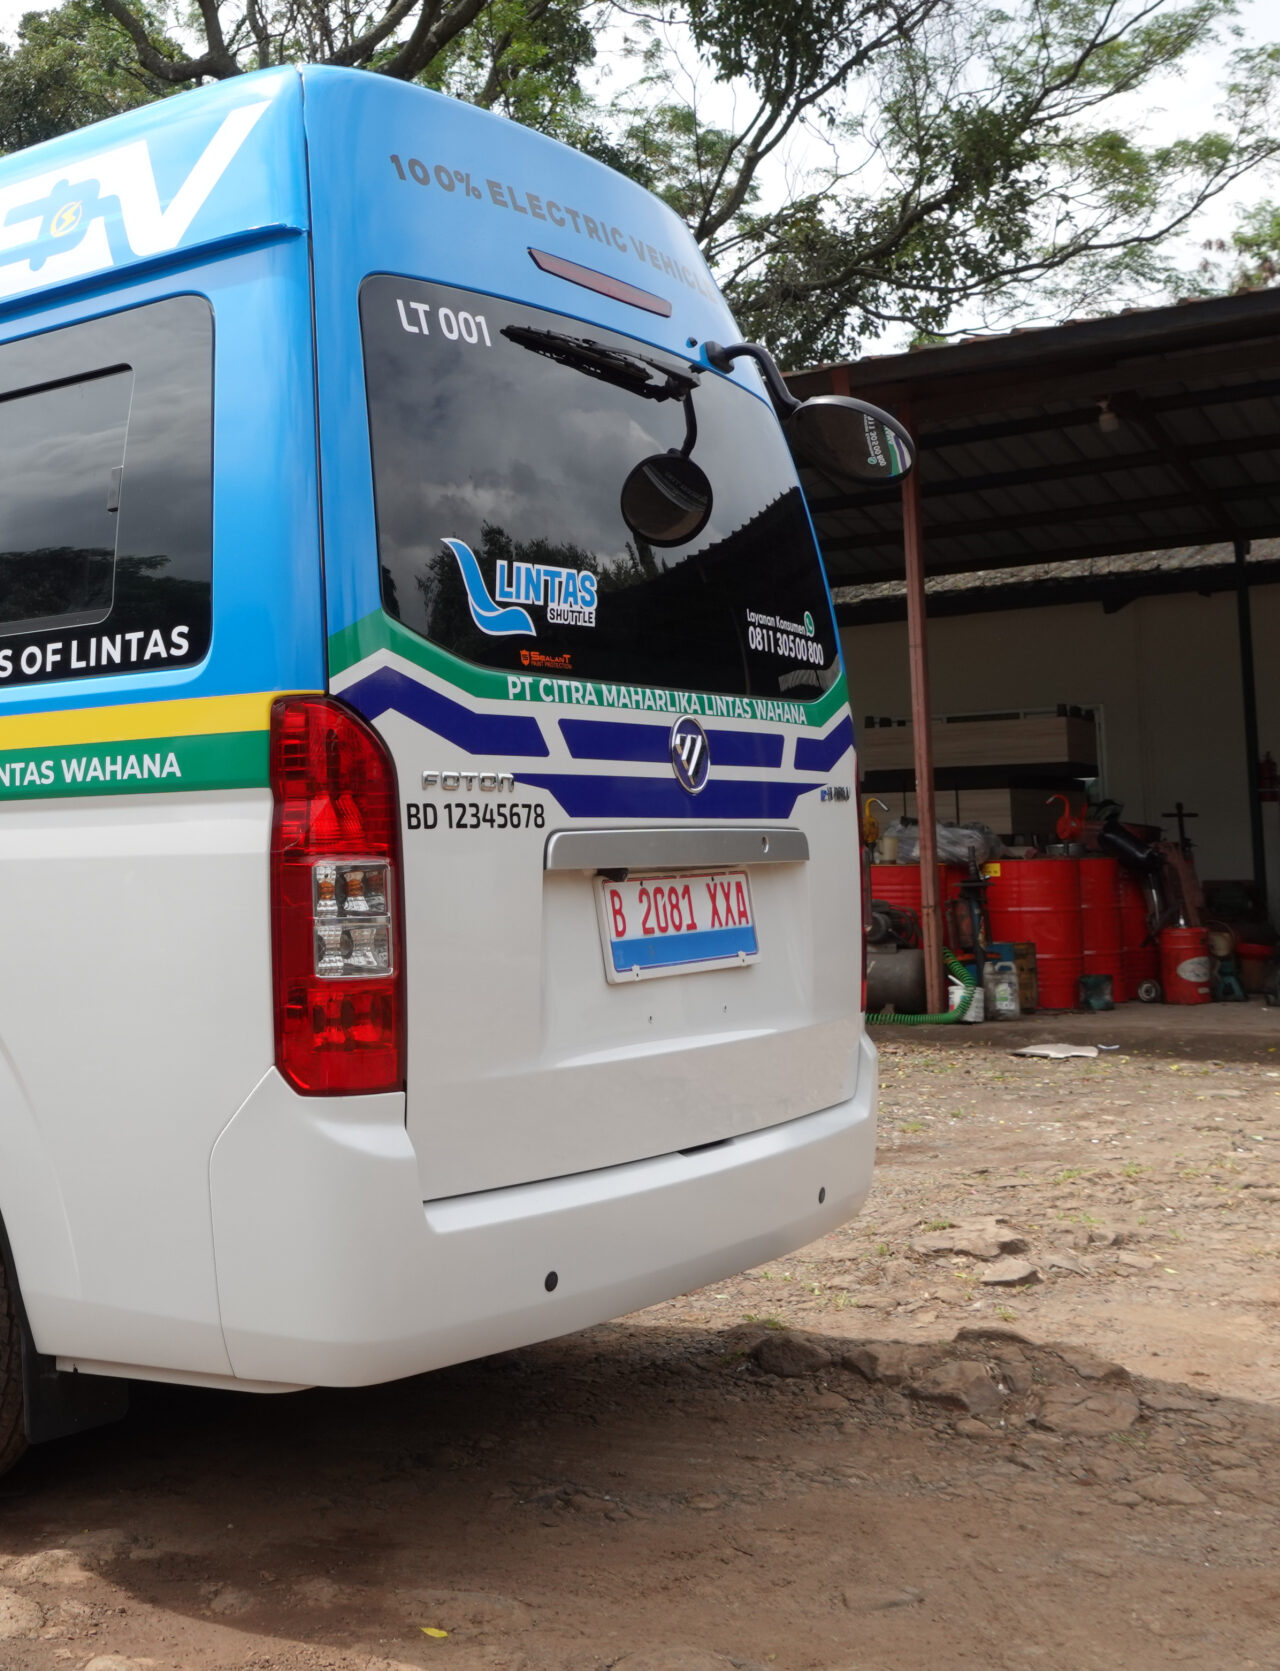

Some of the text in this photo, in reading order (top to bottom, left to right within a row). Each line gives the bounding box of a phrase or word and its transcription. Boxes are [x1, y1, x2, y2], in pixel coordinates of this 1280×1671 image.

[389, 153, 482, 200] 100%
[487, 179, 627, 253] ELECTRIC
[396, 299, 492, 346] LT 001
[495, 559, 598, 612] LINTAS
[547, 604, 596, 627] SHUTTLE
[746, 608, 806, 635] Layanan Konsumen
[21, 642, 62, 675] OF
[70, 625, 190, 669] LINTAS
[748, 626, 774, 653] 0811
[808, 641, 824, 666] 800
[507, 676, 807, 725] PT CITRA MAHARLIKA LINTAS WAHANA
[61, 752, 181, 783] WAHANA
[422, 771, 515, 793] FOTON
[407, 803, 545, 830] BD 12345678
[609, 881, 749, 937] B 2081 XXA
